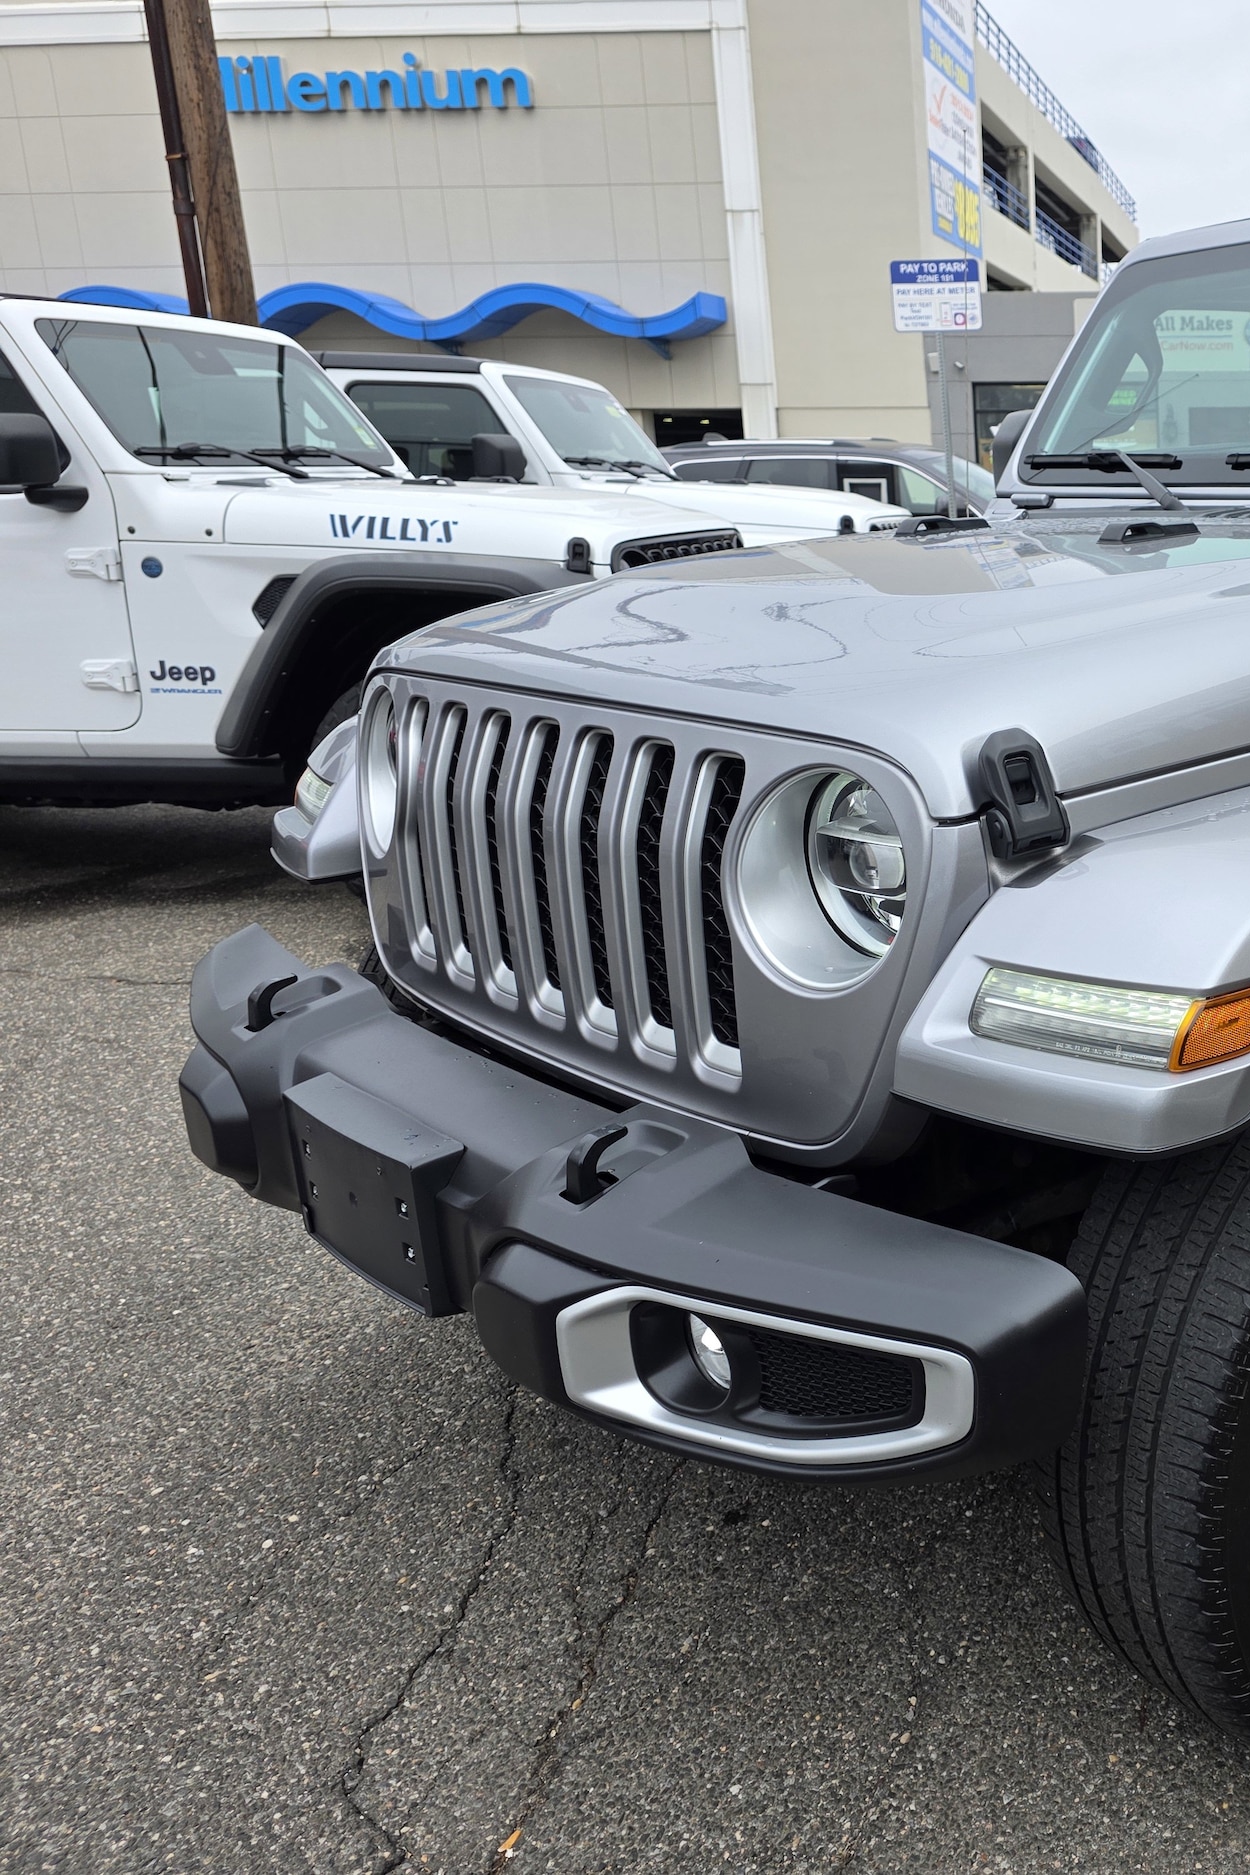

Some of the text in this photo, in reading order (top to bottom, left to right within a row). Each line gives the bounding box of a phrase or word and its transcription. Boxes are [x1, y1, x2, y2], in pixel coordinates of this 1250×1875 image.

[899, 261, 969, 274] PAY TO PARK
[1155, 316, 1176, 332] All
[1180, 315, 1233, 332] Makes
[329, 513, 459, 544] WILLYS
[149, 659, 216, 686] Jeep
